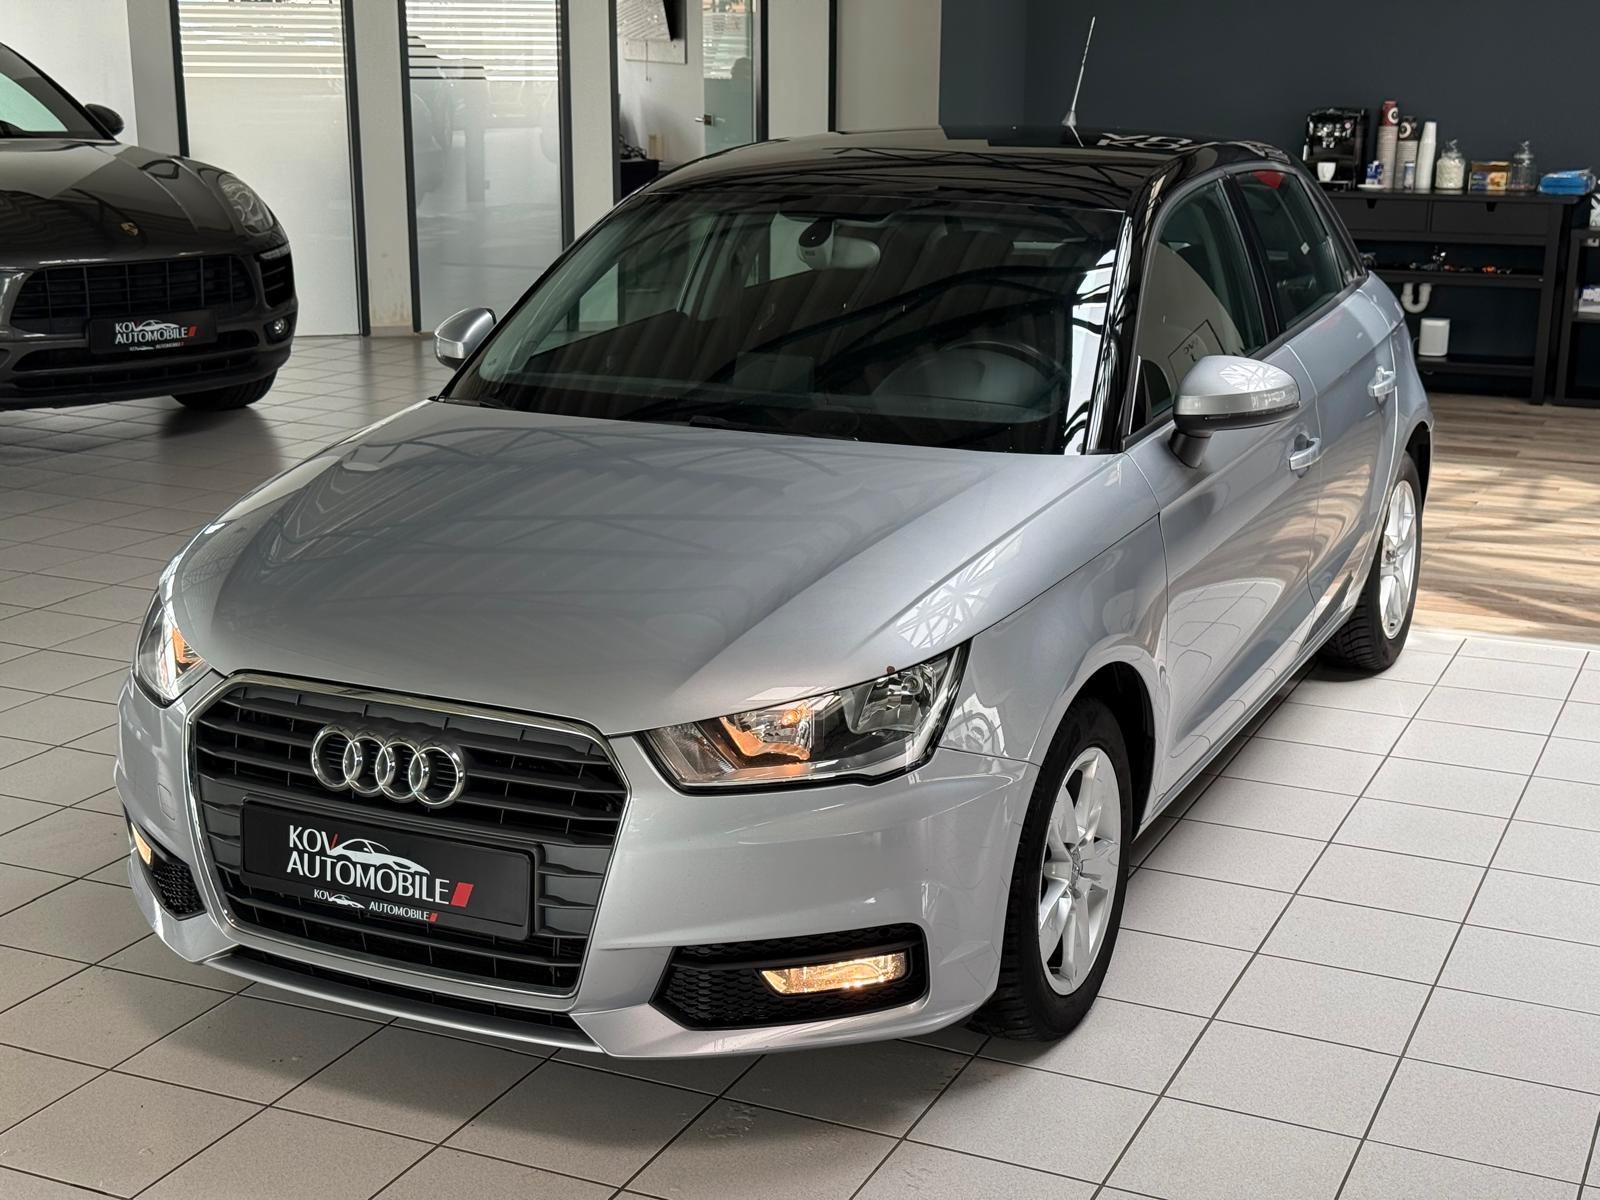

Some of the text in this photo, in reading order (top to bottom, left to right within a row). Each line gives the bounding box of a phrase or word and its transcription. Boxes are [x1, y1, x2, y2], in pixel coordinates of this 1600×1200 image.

[115, 321, 141, 333] KOV
[115, 327, 188, 344] AUTOMOBILE
[288, 825, 339, 854] KOV
[287, 851, 450, 905] AUTOMOBILE
[313, 888, 430, 922] KOV AUTOMOBILE
